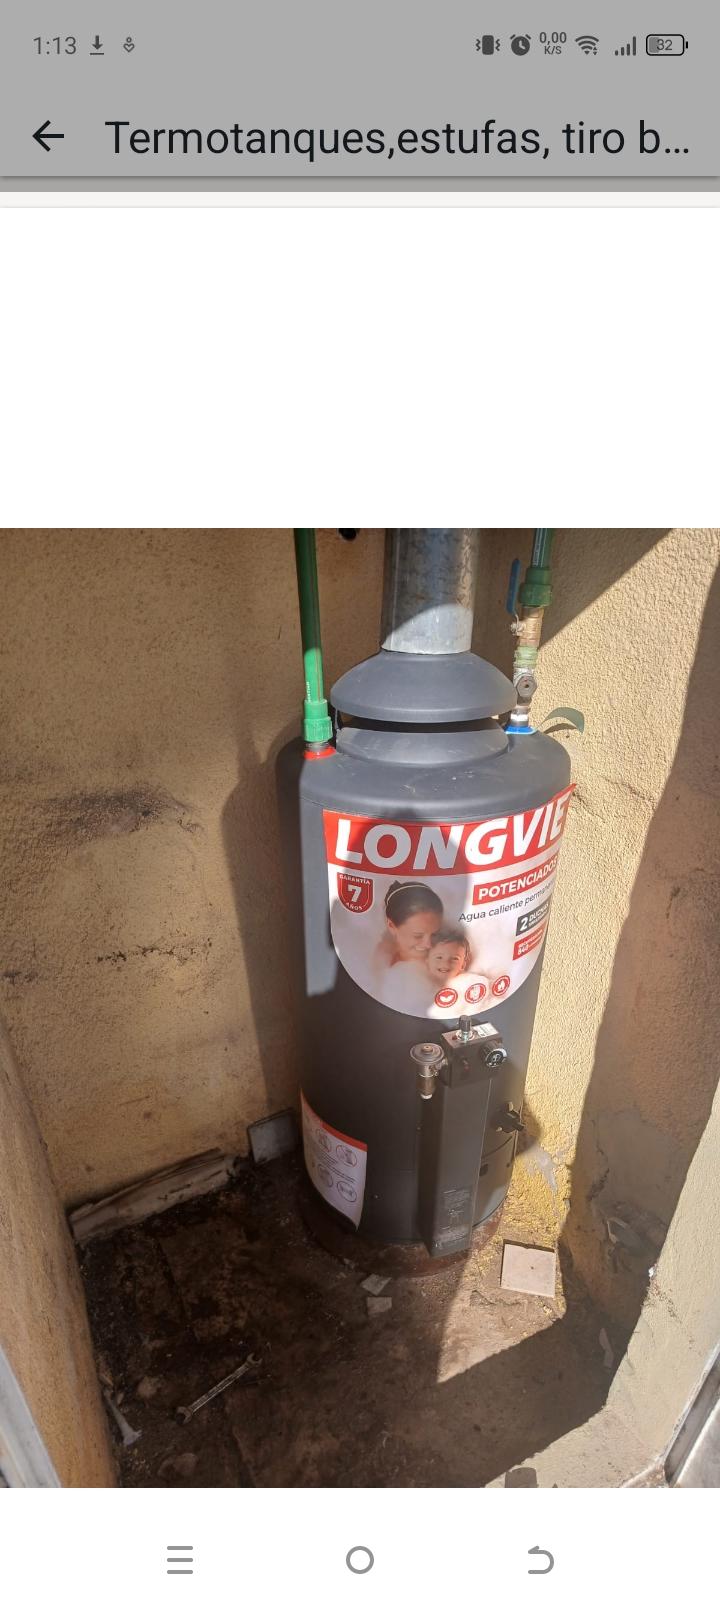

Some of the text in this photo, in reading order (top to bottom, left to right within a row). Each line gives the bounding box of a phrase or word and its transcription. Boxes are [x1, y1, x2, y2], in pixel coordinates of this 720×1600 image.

[34, 37, 77, 54] 1:13
[539, 31, 567, 46] 0,00
[656, 38, 673, 53] 32
[543, 45, 563, 56] K/S
[105, 119, 550, 162] Termotanques,estufas,
[562, 120, 625, 155] tiro
[477, 855, 557, 901] POTENCIADOS
[347, 884, 362, 903] 7
[457, 910, 486, 923] Agua
[488, 900, 523, 917] caliente
[519, 916, 529, 932] 2
